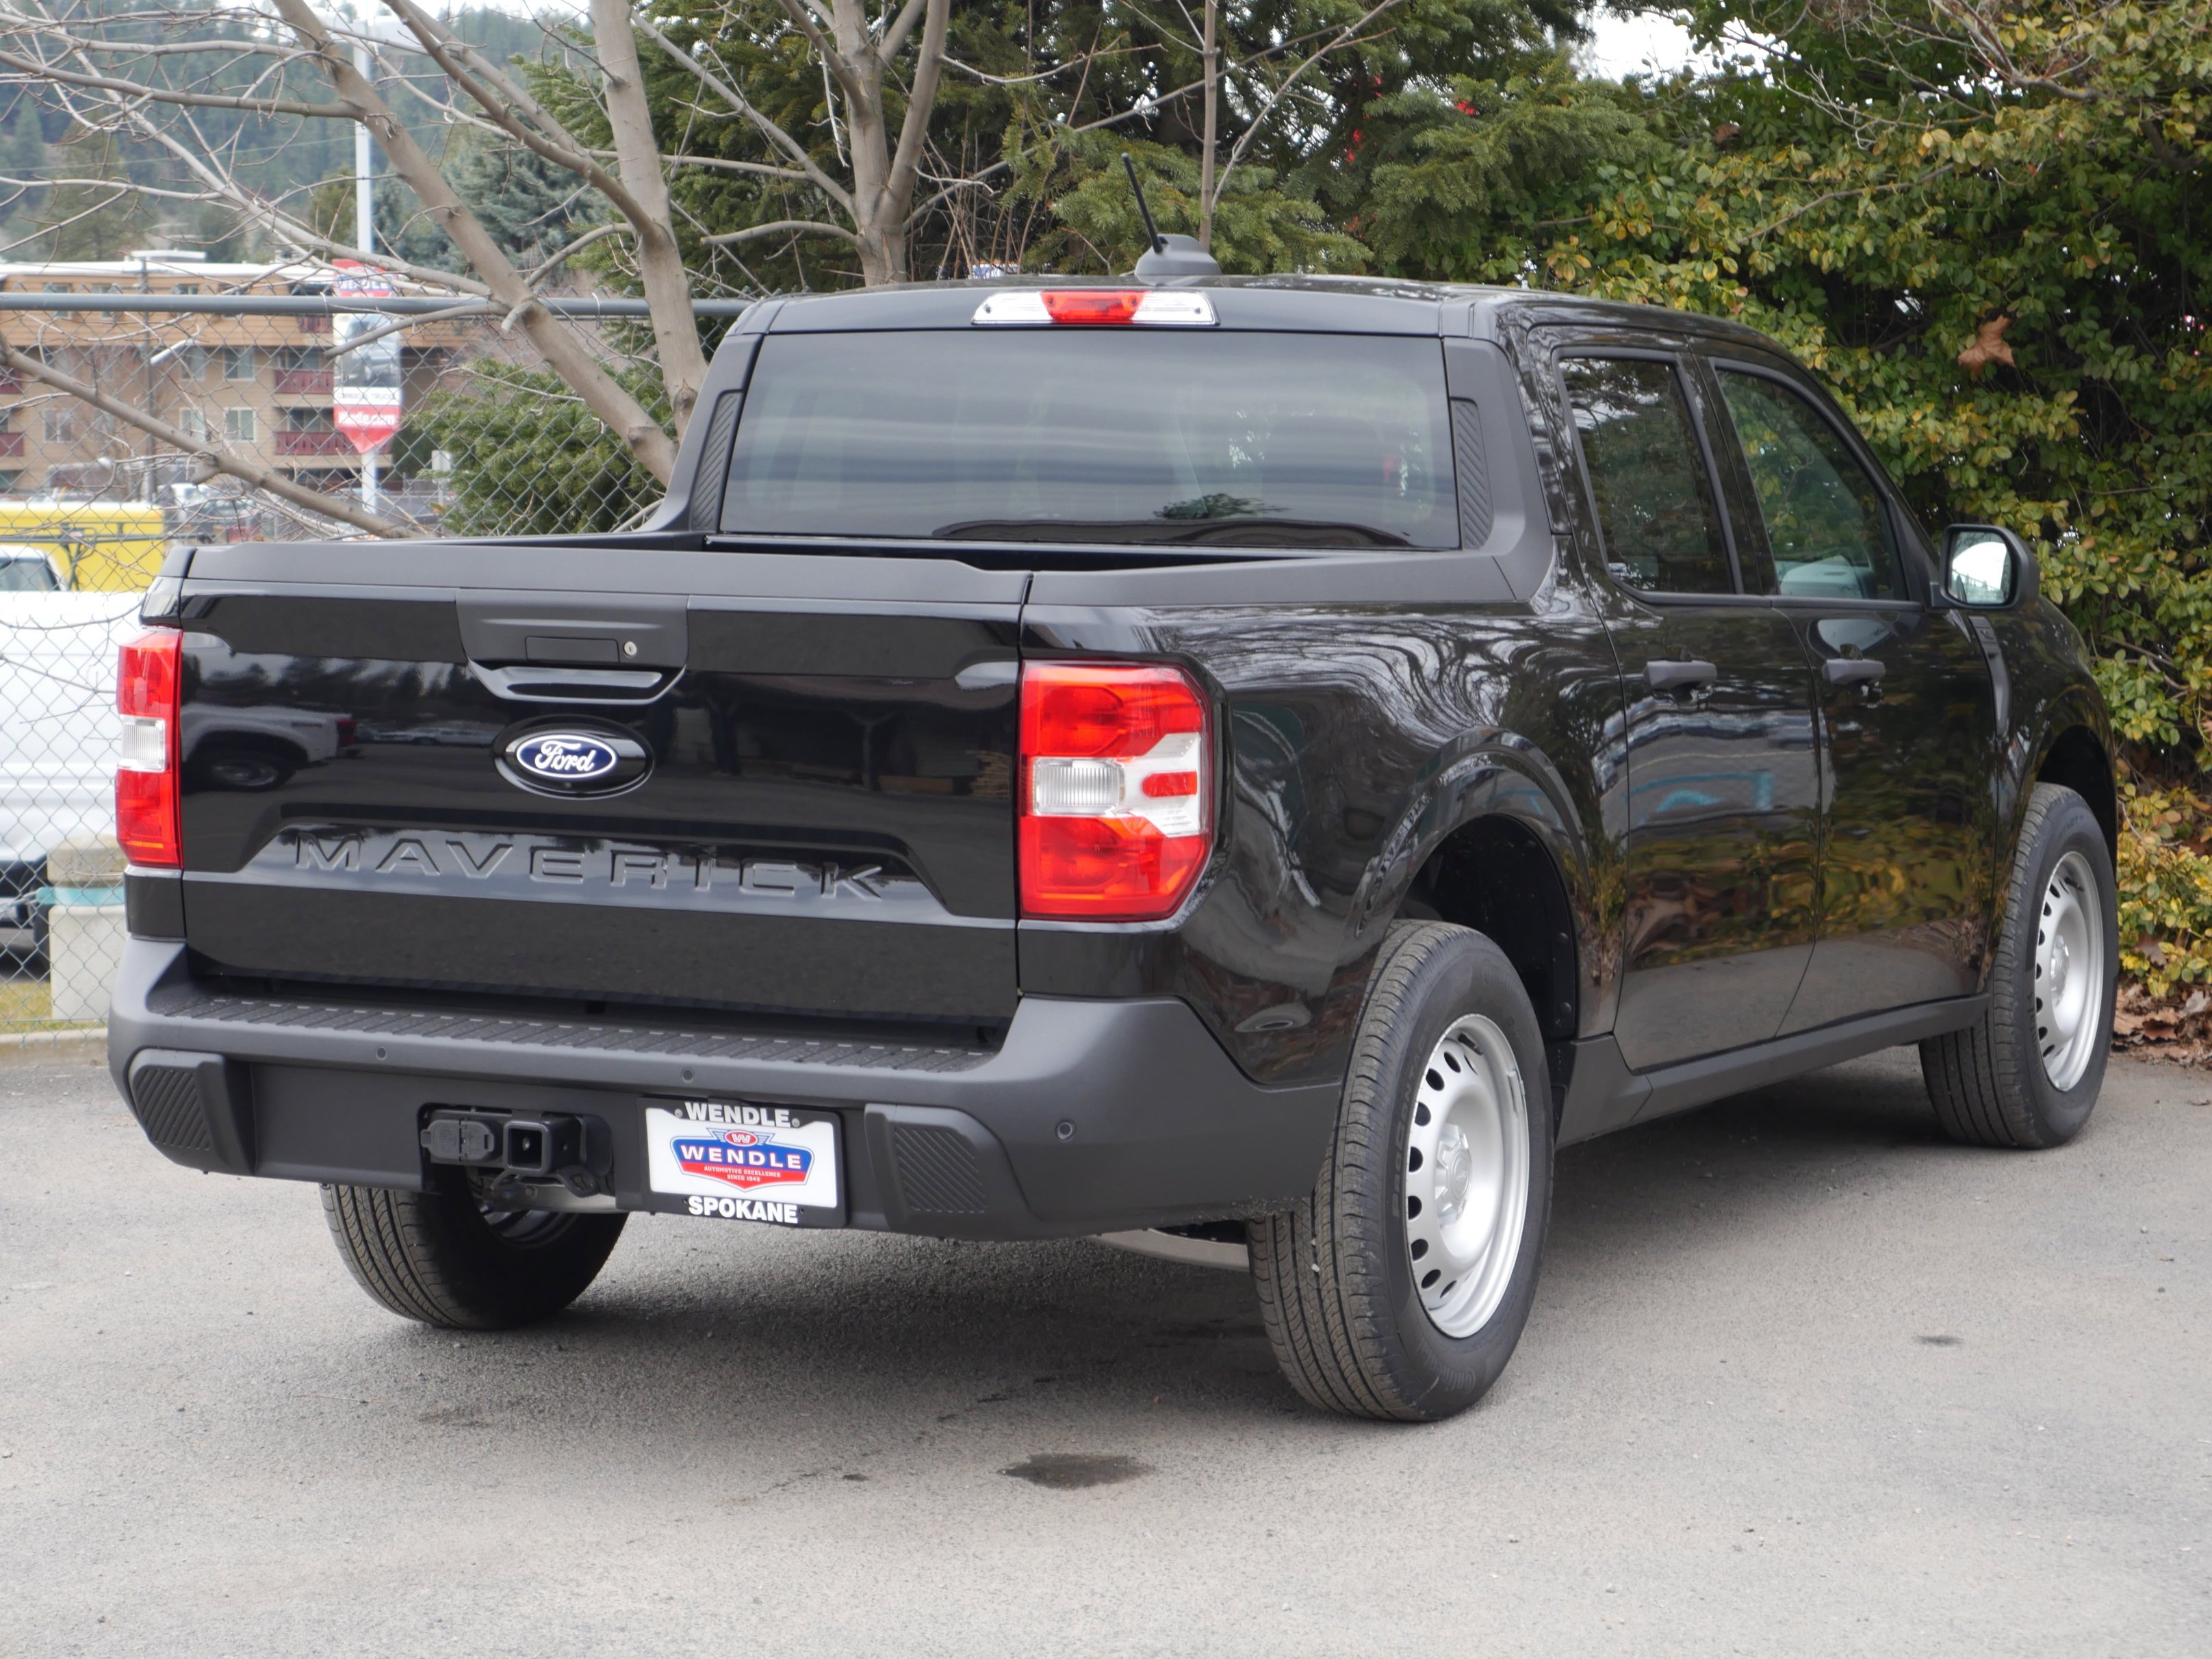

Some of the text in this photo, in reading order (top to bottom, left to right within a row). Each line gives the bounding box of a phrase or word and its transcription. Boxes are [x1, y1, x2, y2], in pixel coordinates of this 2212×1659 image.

[535, 740, 596, 771] Ford
[296, 832, 883, 901] MAVERICK
[684, 1101, 791, 1128] WENDLE
[680, 1145, 801, 1169] WENDLE
[704, 1166, 781, 1178] AUTOMOTIVE EXCELLENCE
[688, 1195, 799, 1224] SPOKANE
